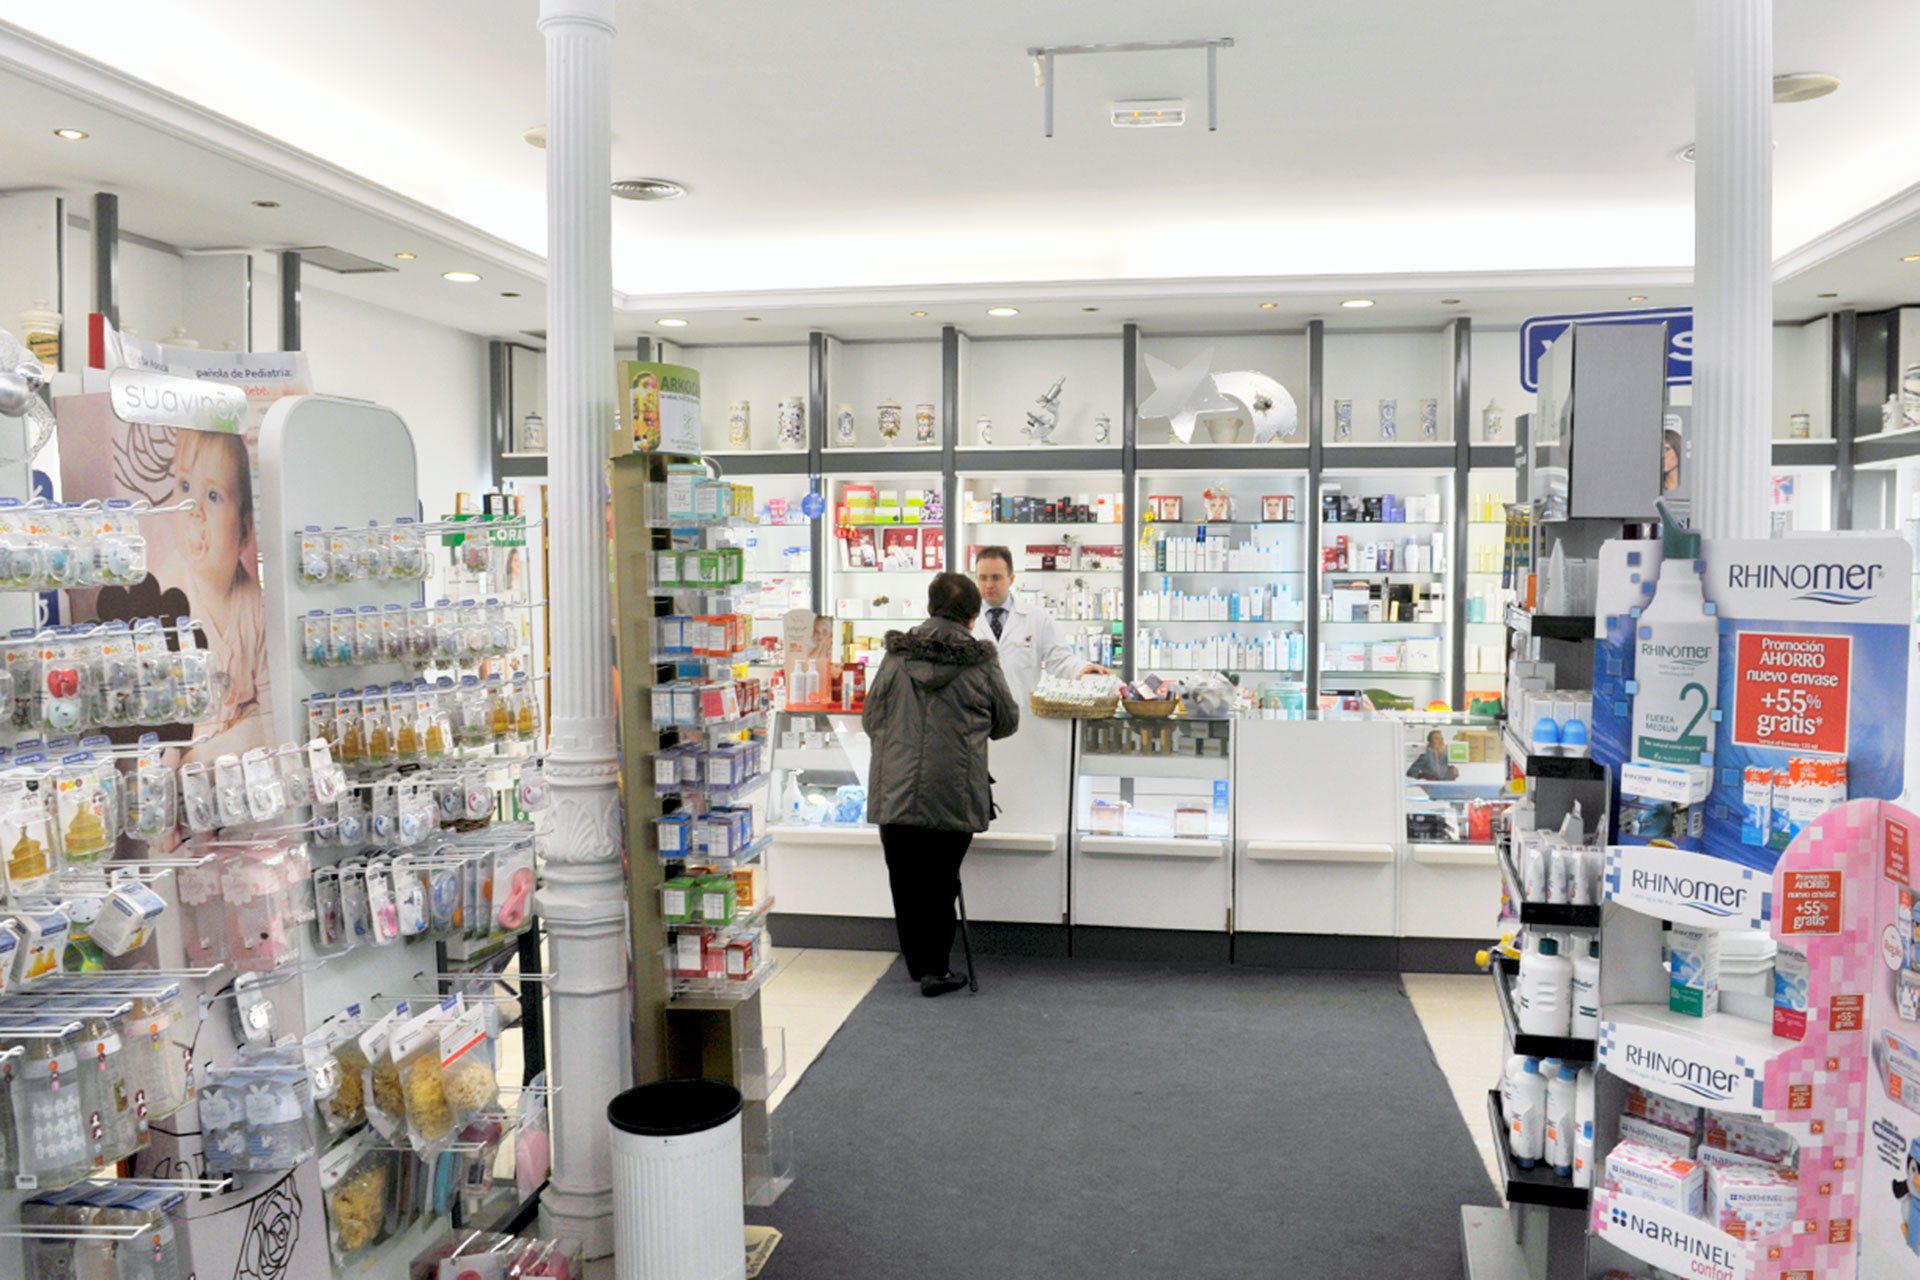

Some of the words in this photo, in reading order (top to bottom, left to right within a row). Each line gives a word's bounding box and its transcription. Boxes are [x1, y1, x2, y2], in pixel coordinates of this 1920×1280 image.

[1762, 637, 1825, 653] Promoción
[1759, 652, 1826, 669] AHORRO
[1746, 669, 1788, 683] nuevo
[1791, 673, 1839, 687] envase
[1760, 688, 1822, 714] +55%
[1678, 682, 1709, 741] 2
[1793, 880, 1830, 890] AHORRO
[1690, 1258, 1734, 1280] confort
